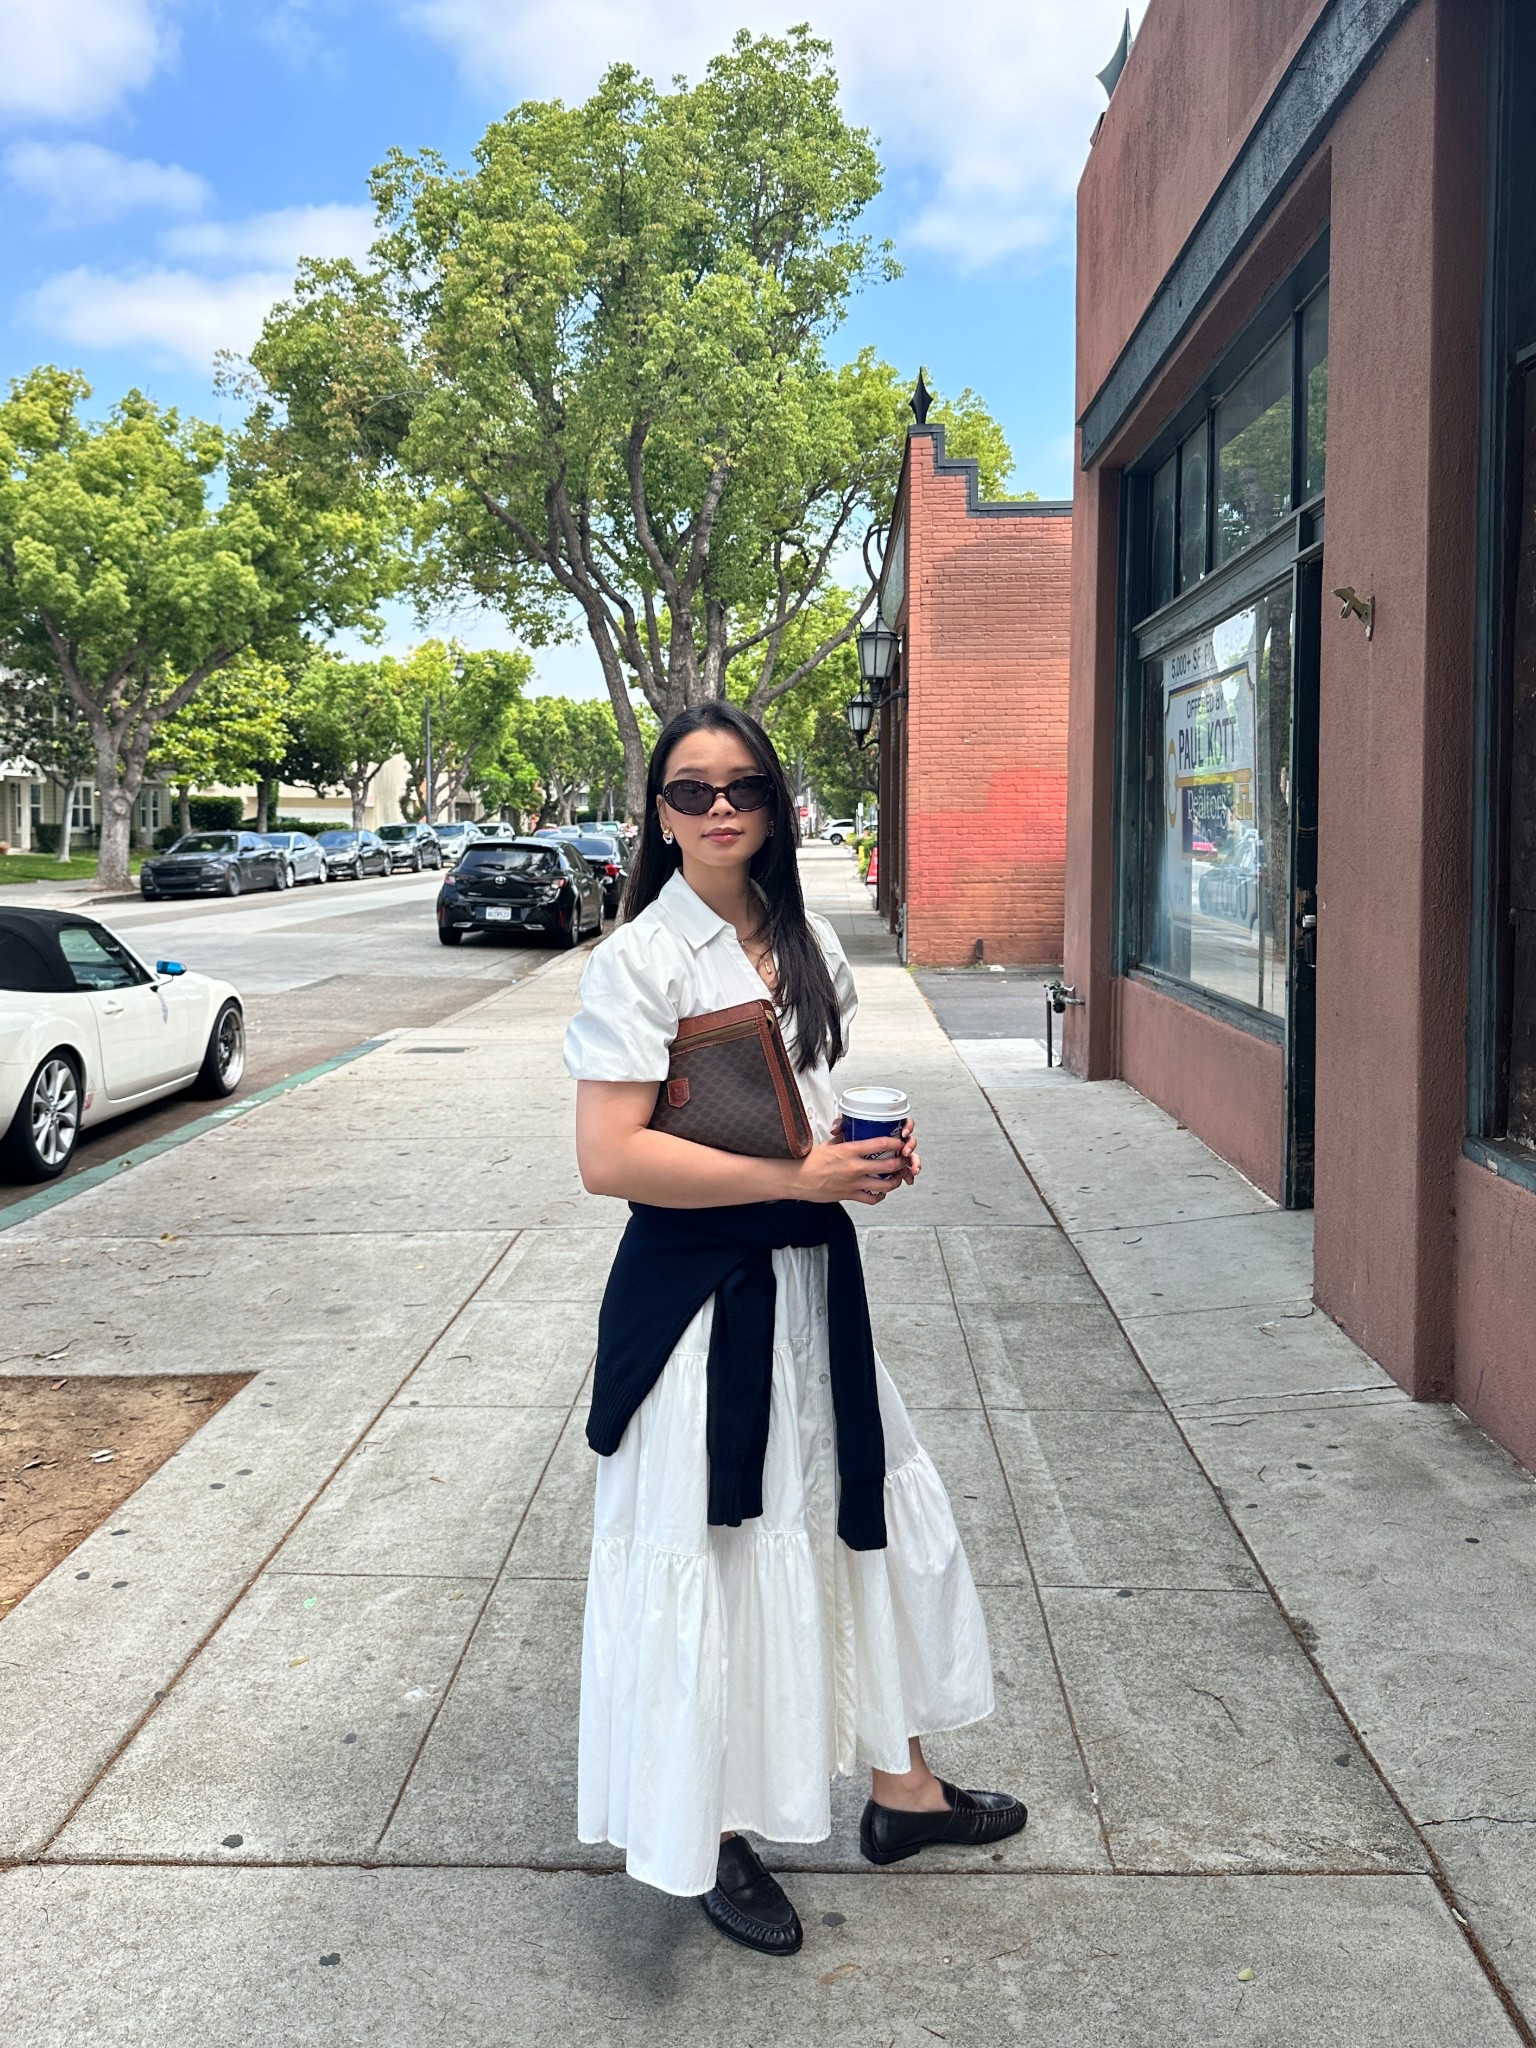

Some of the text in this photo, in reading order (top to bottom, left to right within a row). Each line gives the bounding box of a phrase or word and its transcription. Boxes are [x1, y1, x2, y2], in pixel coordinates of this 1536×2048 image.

[1187, 693, 1214, 719] OFFERED
[1179, 716, 1236, 770] PAUL KOTT
